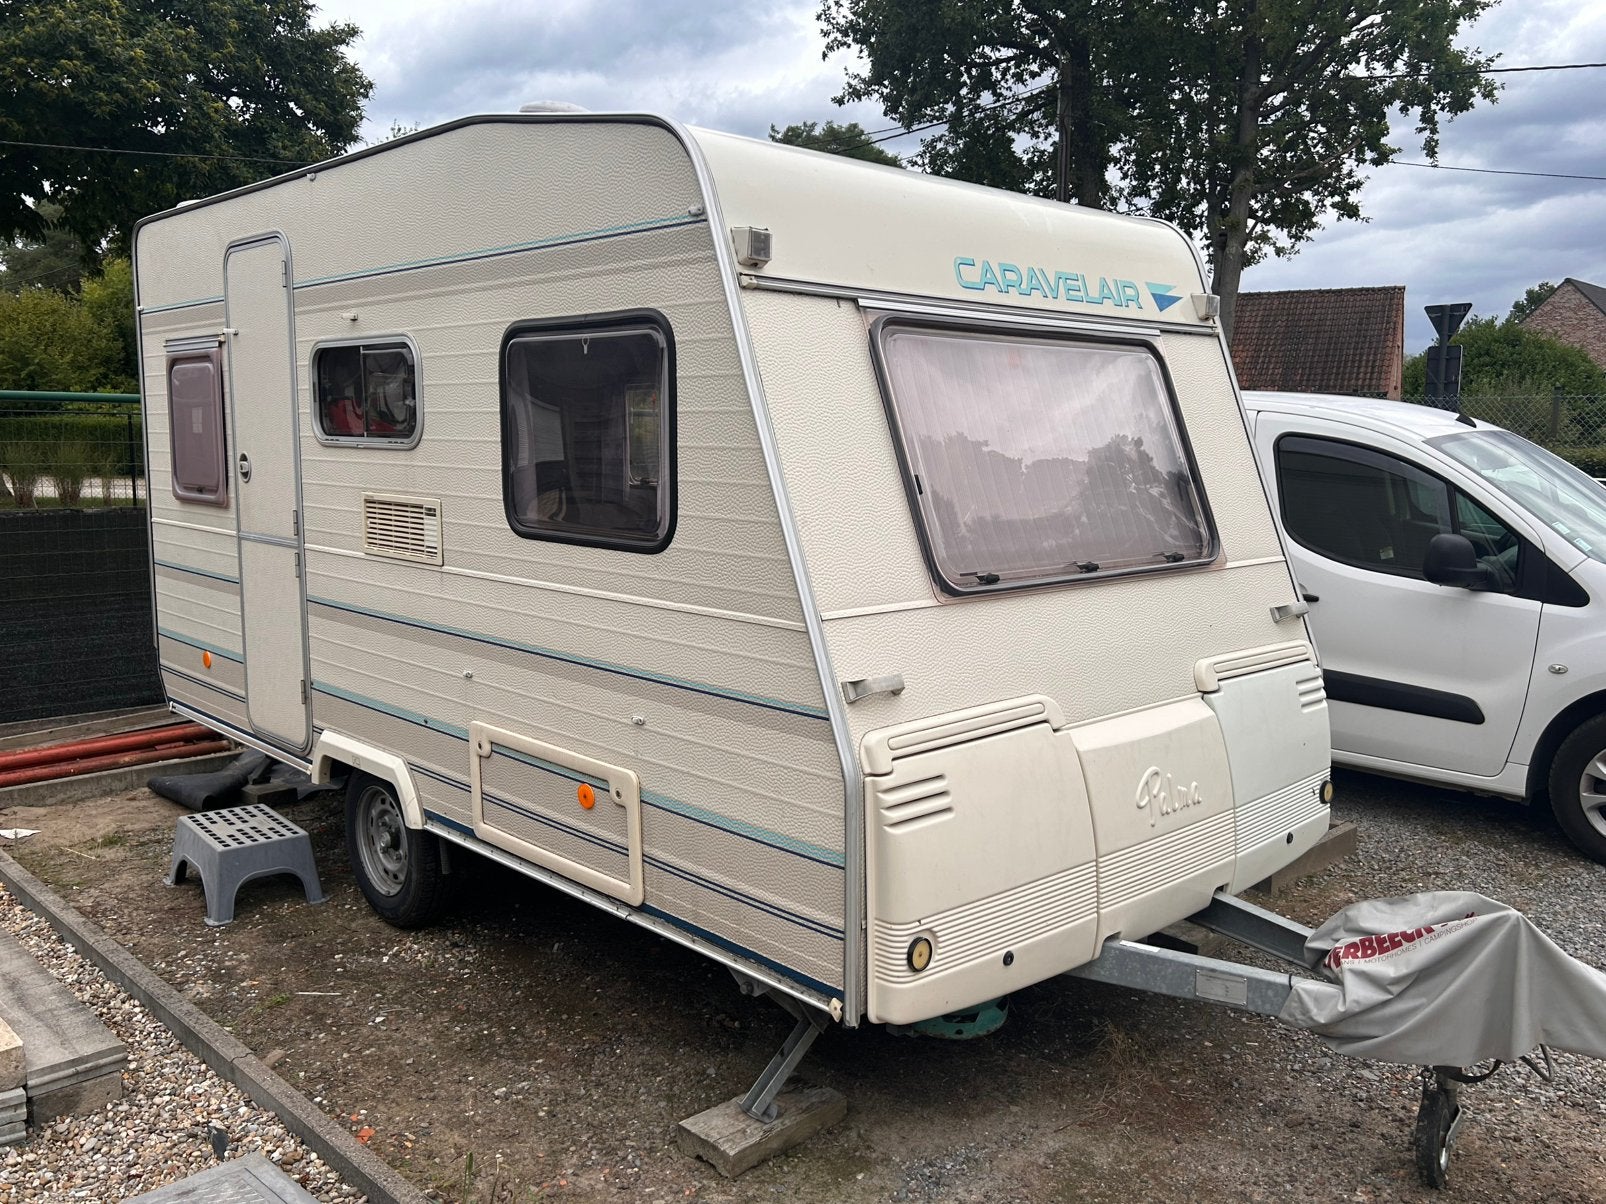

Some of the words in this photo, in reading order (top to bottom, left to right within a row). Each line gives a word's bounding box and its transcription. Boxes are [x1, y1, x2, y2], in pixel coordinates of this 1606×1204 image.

[953, 256, 1143, 310] CARAVELAIR
[1135, 766, 1202, 828] Palma
[1364, 942, 1418, 965] MOTORHOMES
